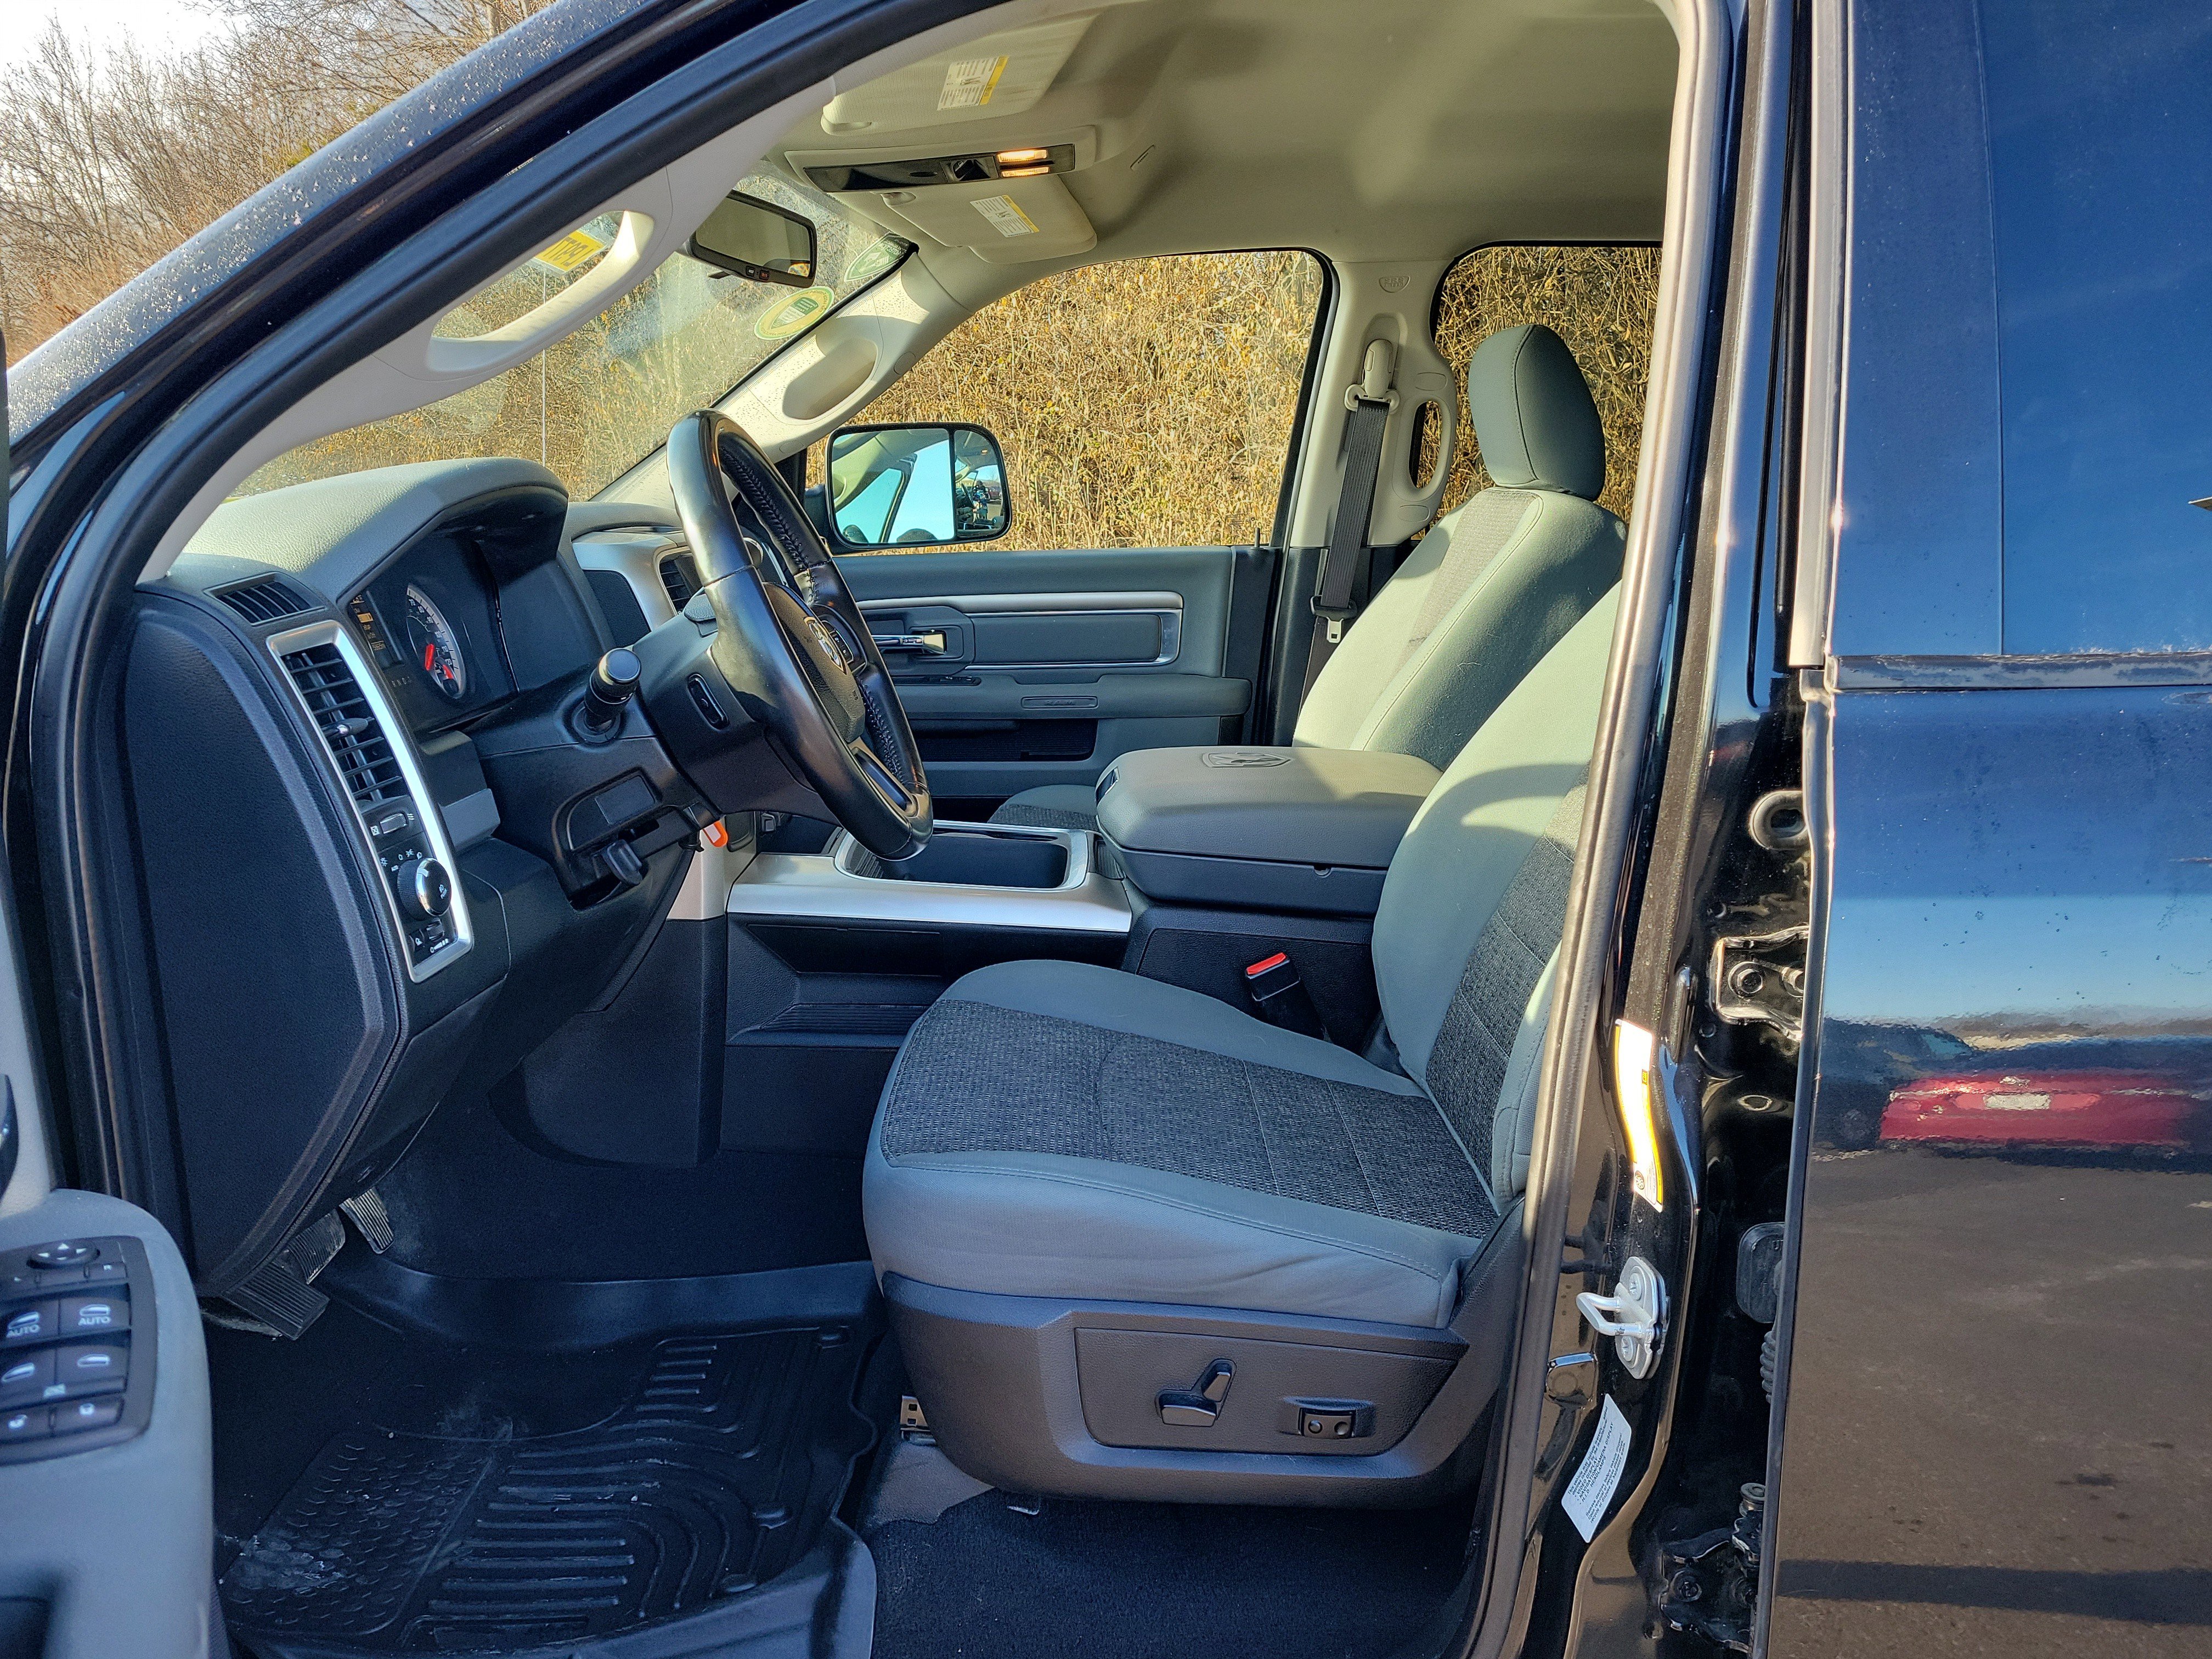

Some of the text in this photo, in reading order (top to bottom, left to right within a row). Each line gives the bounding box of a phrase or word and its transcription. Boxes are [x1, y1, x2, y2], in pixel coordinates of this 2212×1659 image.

[6, 1324, 41, 1338] AUTO
[78, 1316, 111, 1326] AUTO
[1577, 1456, 1598, 1494] VIDEO DISPLAY
[1579, 1421, 1613, 1499] NAVIGATION/CAMERA DISPLAY
[1590, 1455, 1606, 1487] HEADLAMPS
[1572, 1480, 1582, 1495] devices
[1581, 1460, 1592, 1479] installed
[1573, 1471, 1583, 1486] vehicle
[1594, 1491, 1604, 1508] removal
[1606, 1469, 1615, 1486] devices
[1585, 1499, 1596, 1517] Remove
[1595, 1483, 1605, 1499] devices
[1590, 1508, 1600, 1523] recycle
[1601, 1485, 1611, 1503] dispose
